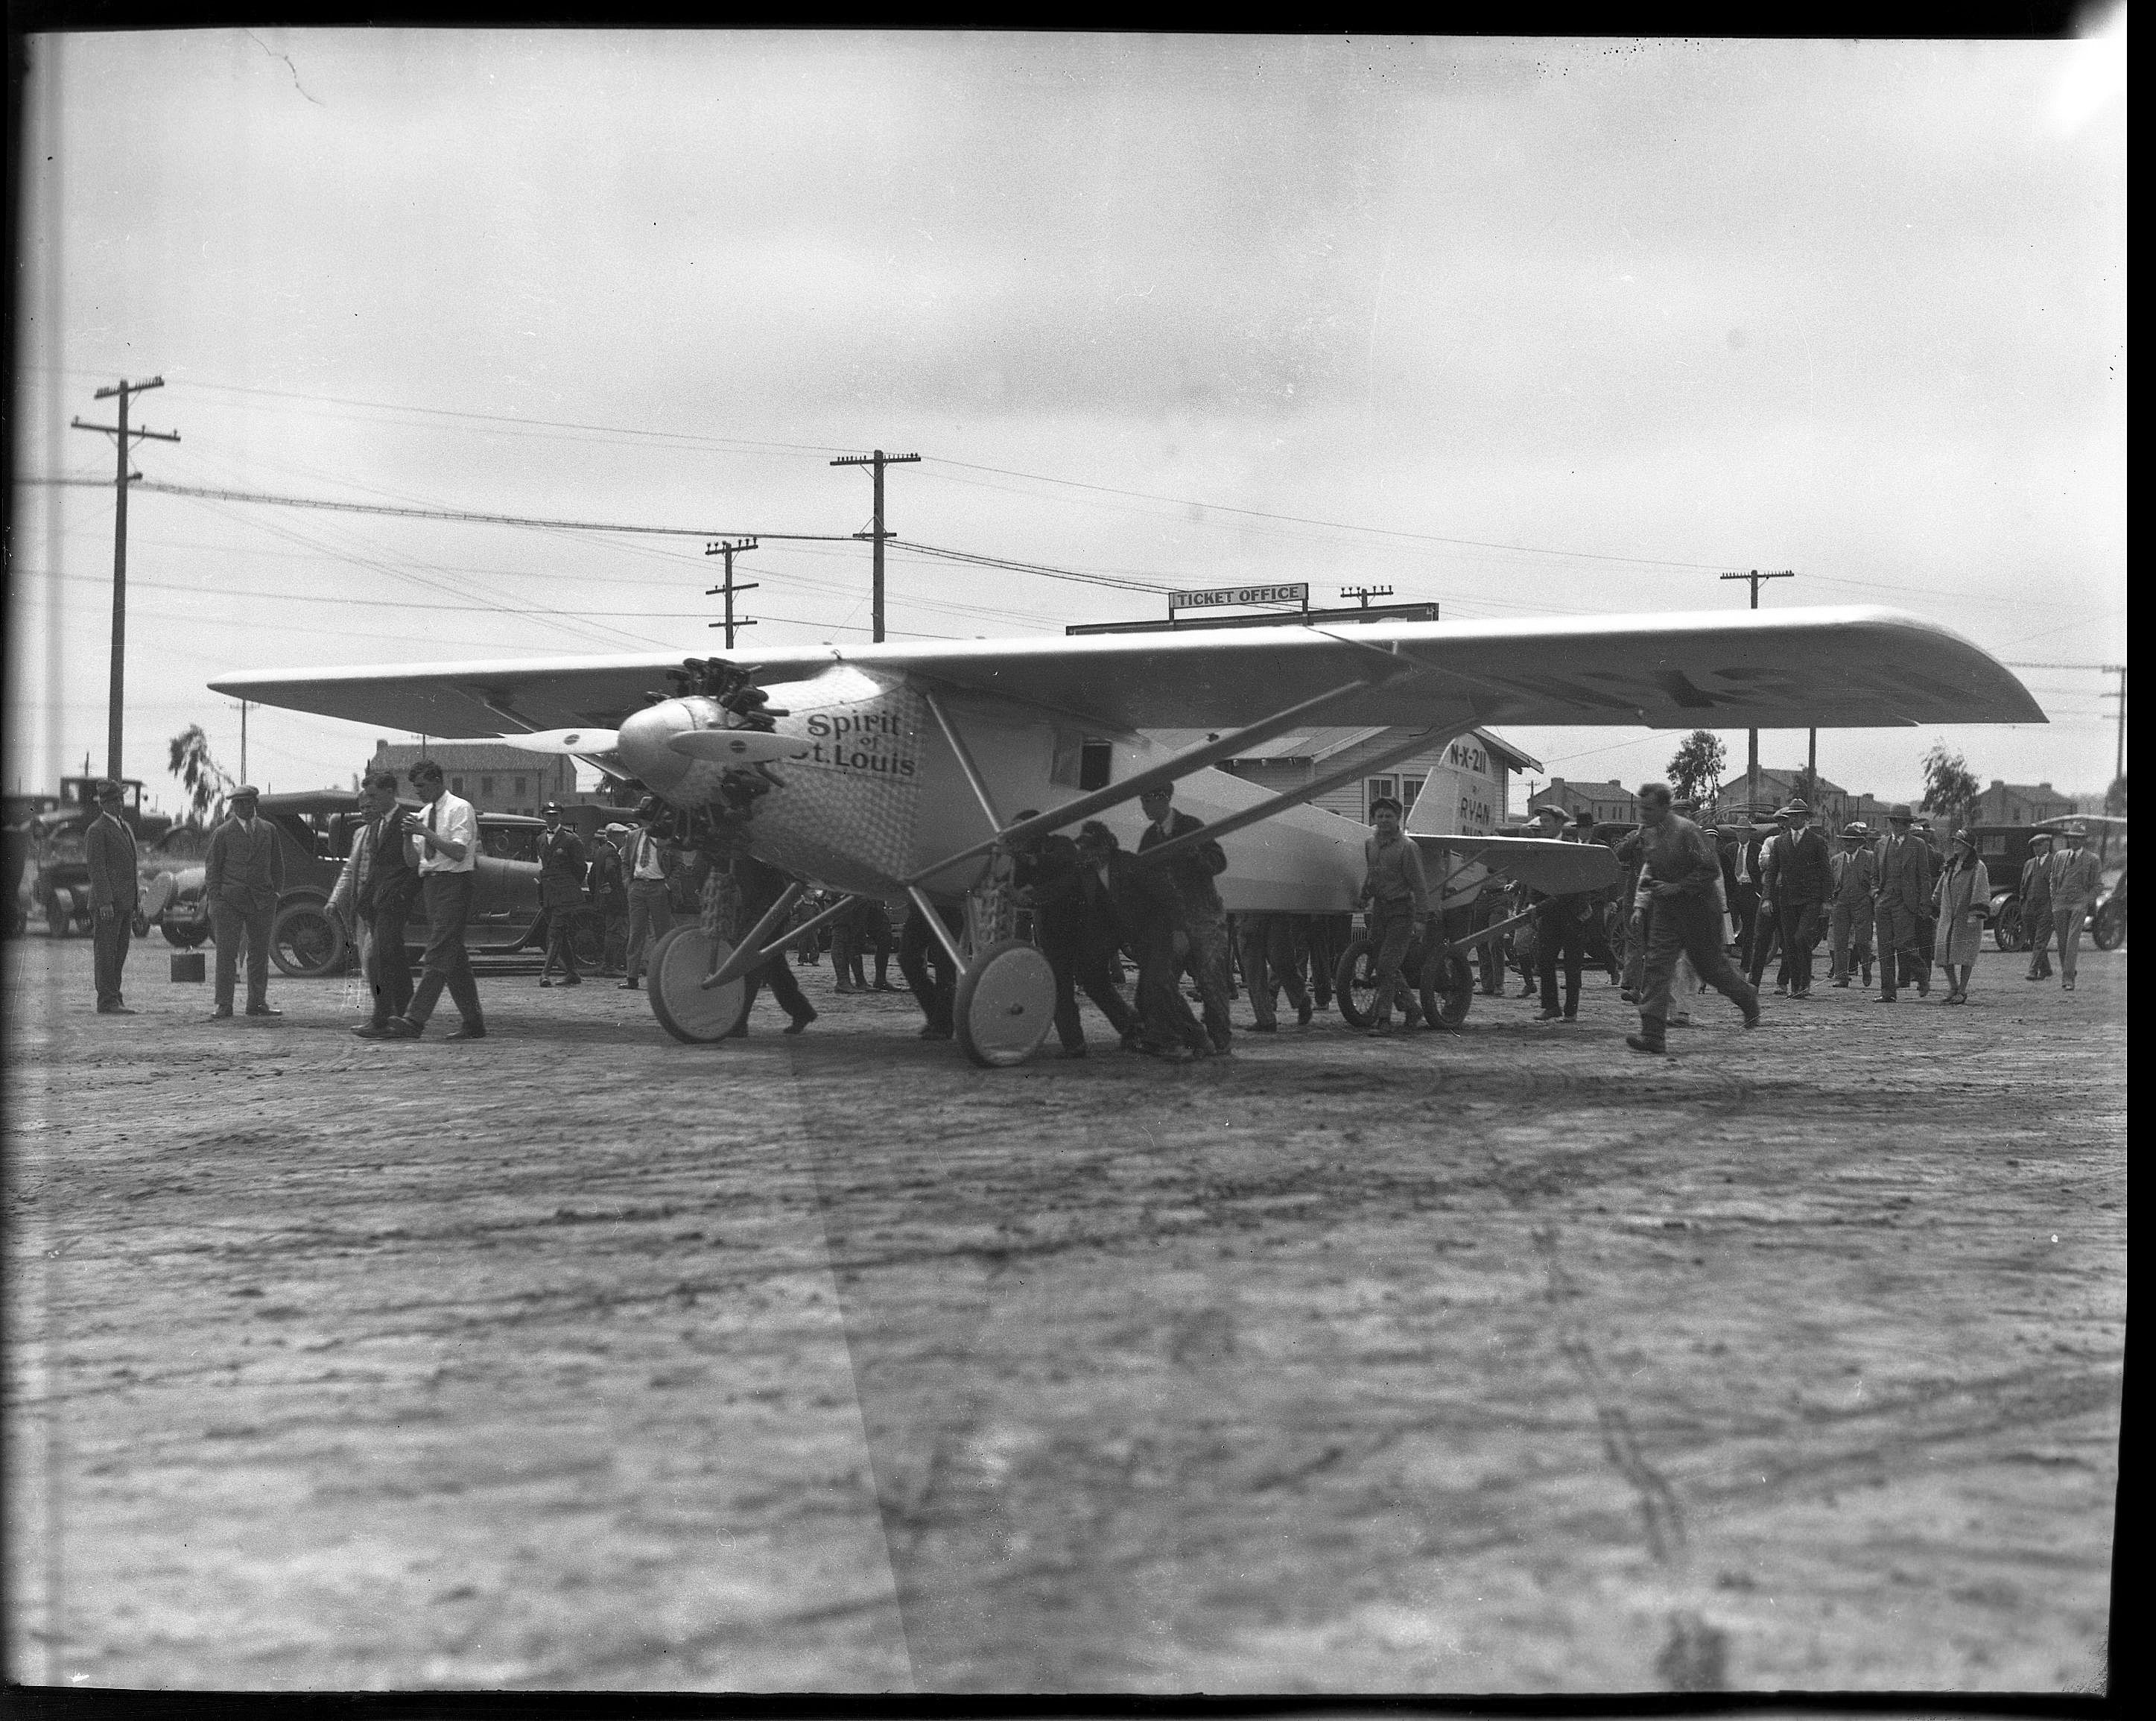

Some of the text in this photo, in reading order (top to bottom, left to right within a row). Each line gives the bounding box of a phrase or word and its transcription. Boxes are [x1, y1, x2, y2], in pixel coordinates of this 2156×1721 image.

[1177, 586, 1299, 606] TICKET OFFICE
[807, 709, 900, 740] Spirit
[860, 734, 882, 751] of
[835, 745, 916, 776] Louis
[1450, 744, 1486, 775] N-X-211
[1460, 796, 1491, 826] RYAN
